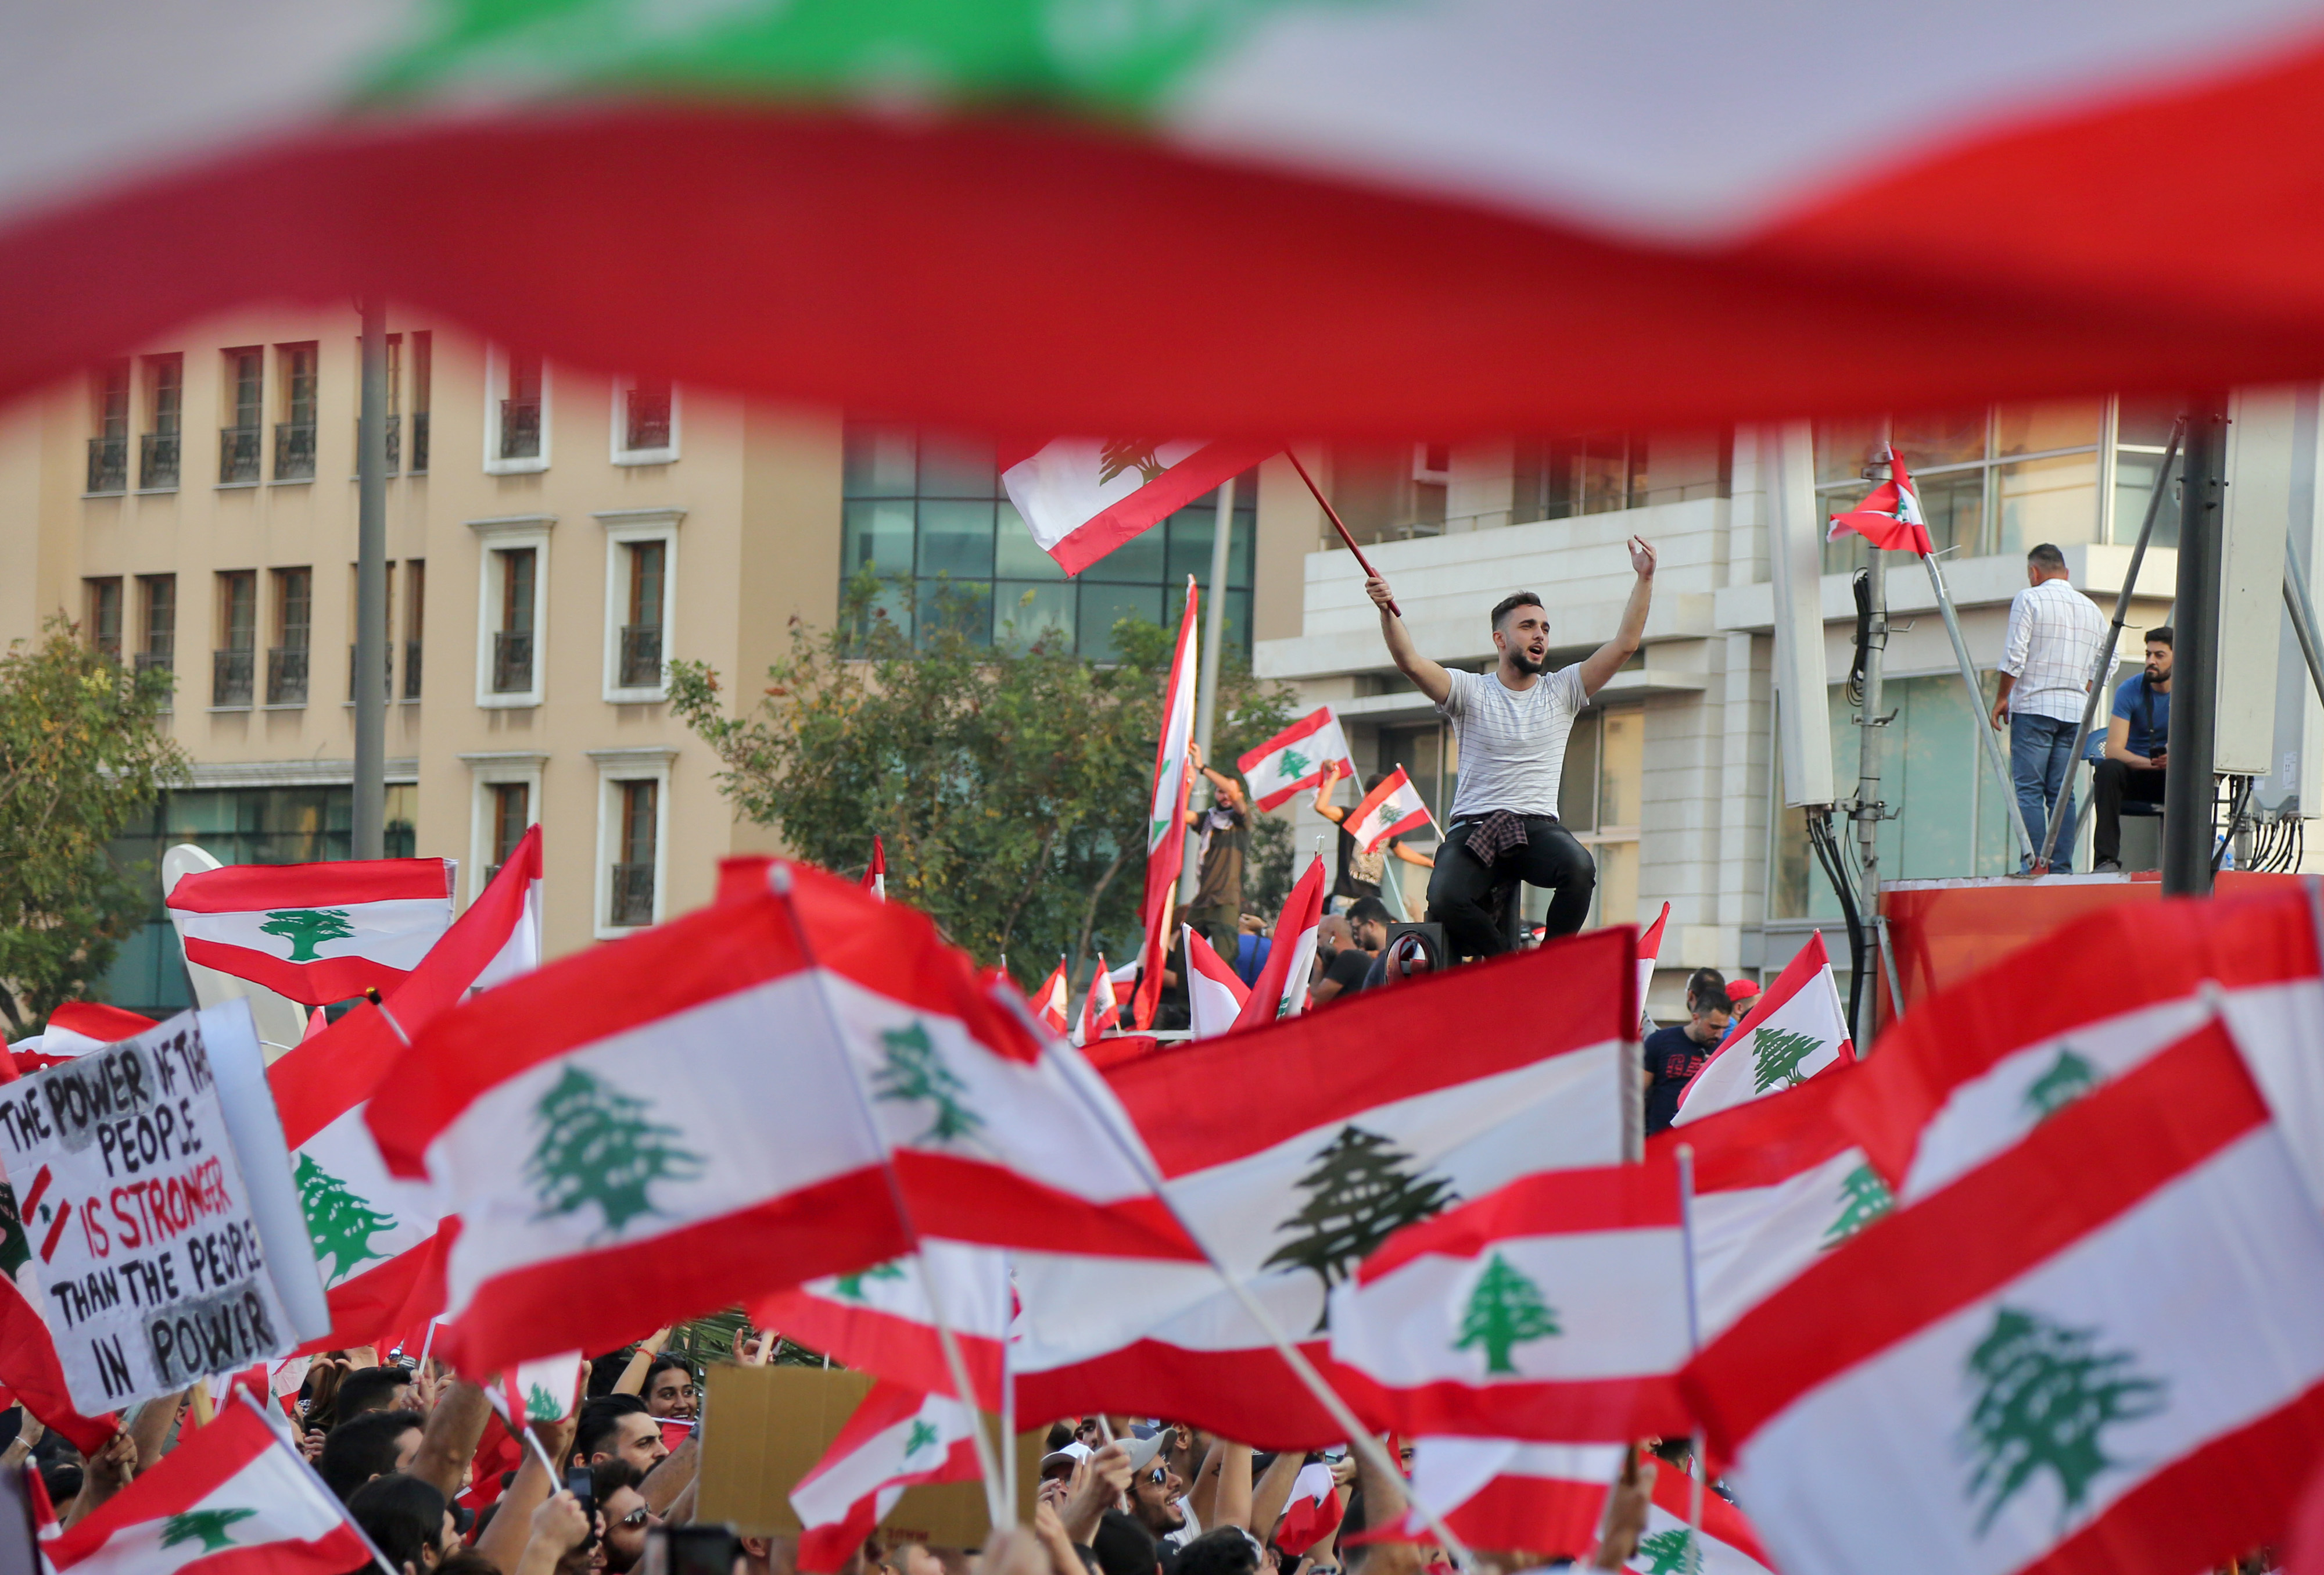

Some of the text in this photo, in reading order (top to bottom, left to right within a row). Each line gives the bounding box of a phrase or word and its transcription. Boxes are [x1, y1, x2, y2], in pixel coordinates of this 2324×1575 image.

[0, 1088, 51, 1152] THE
[45, 1050, 149, 1137] POWER
[98, 1098, 202, 1177] PEOPLE
[80, 1155, 232, 1259] IS STRONGER
[51, 1219, 262, 1329] THAN THE PEOPLE
[92, 1291, 273, 1398] IN POWER
